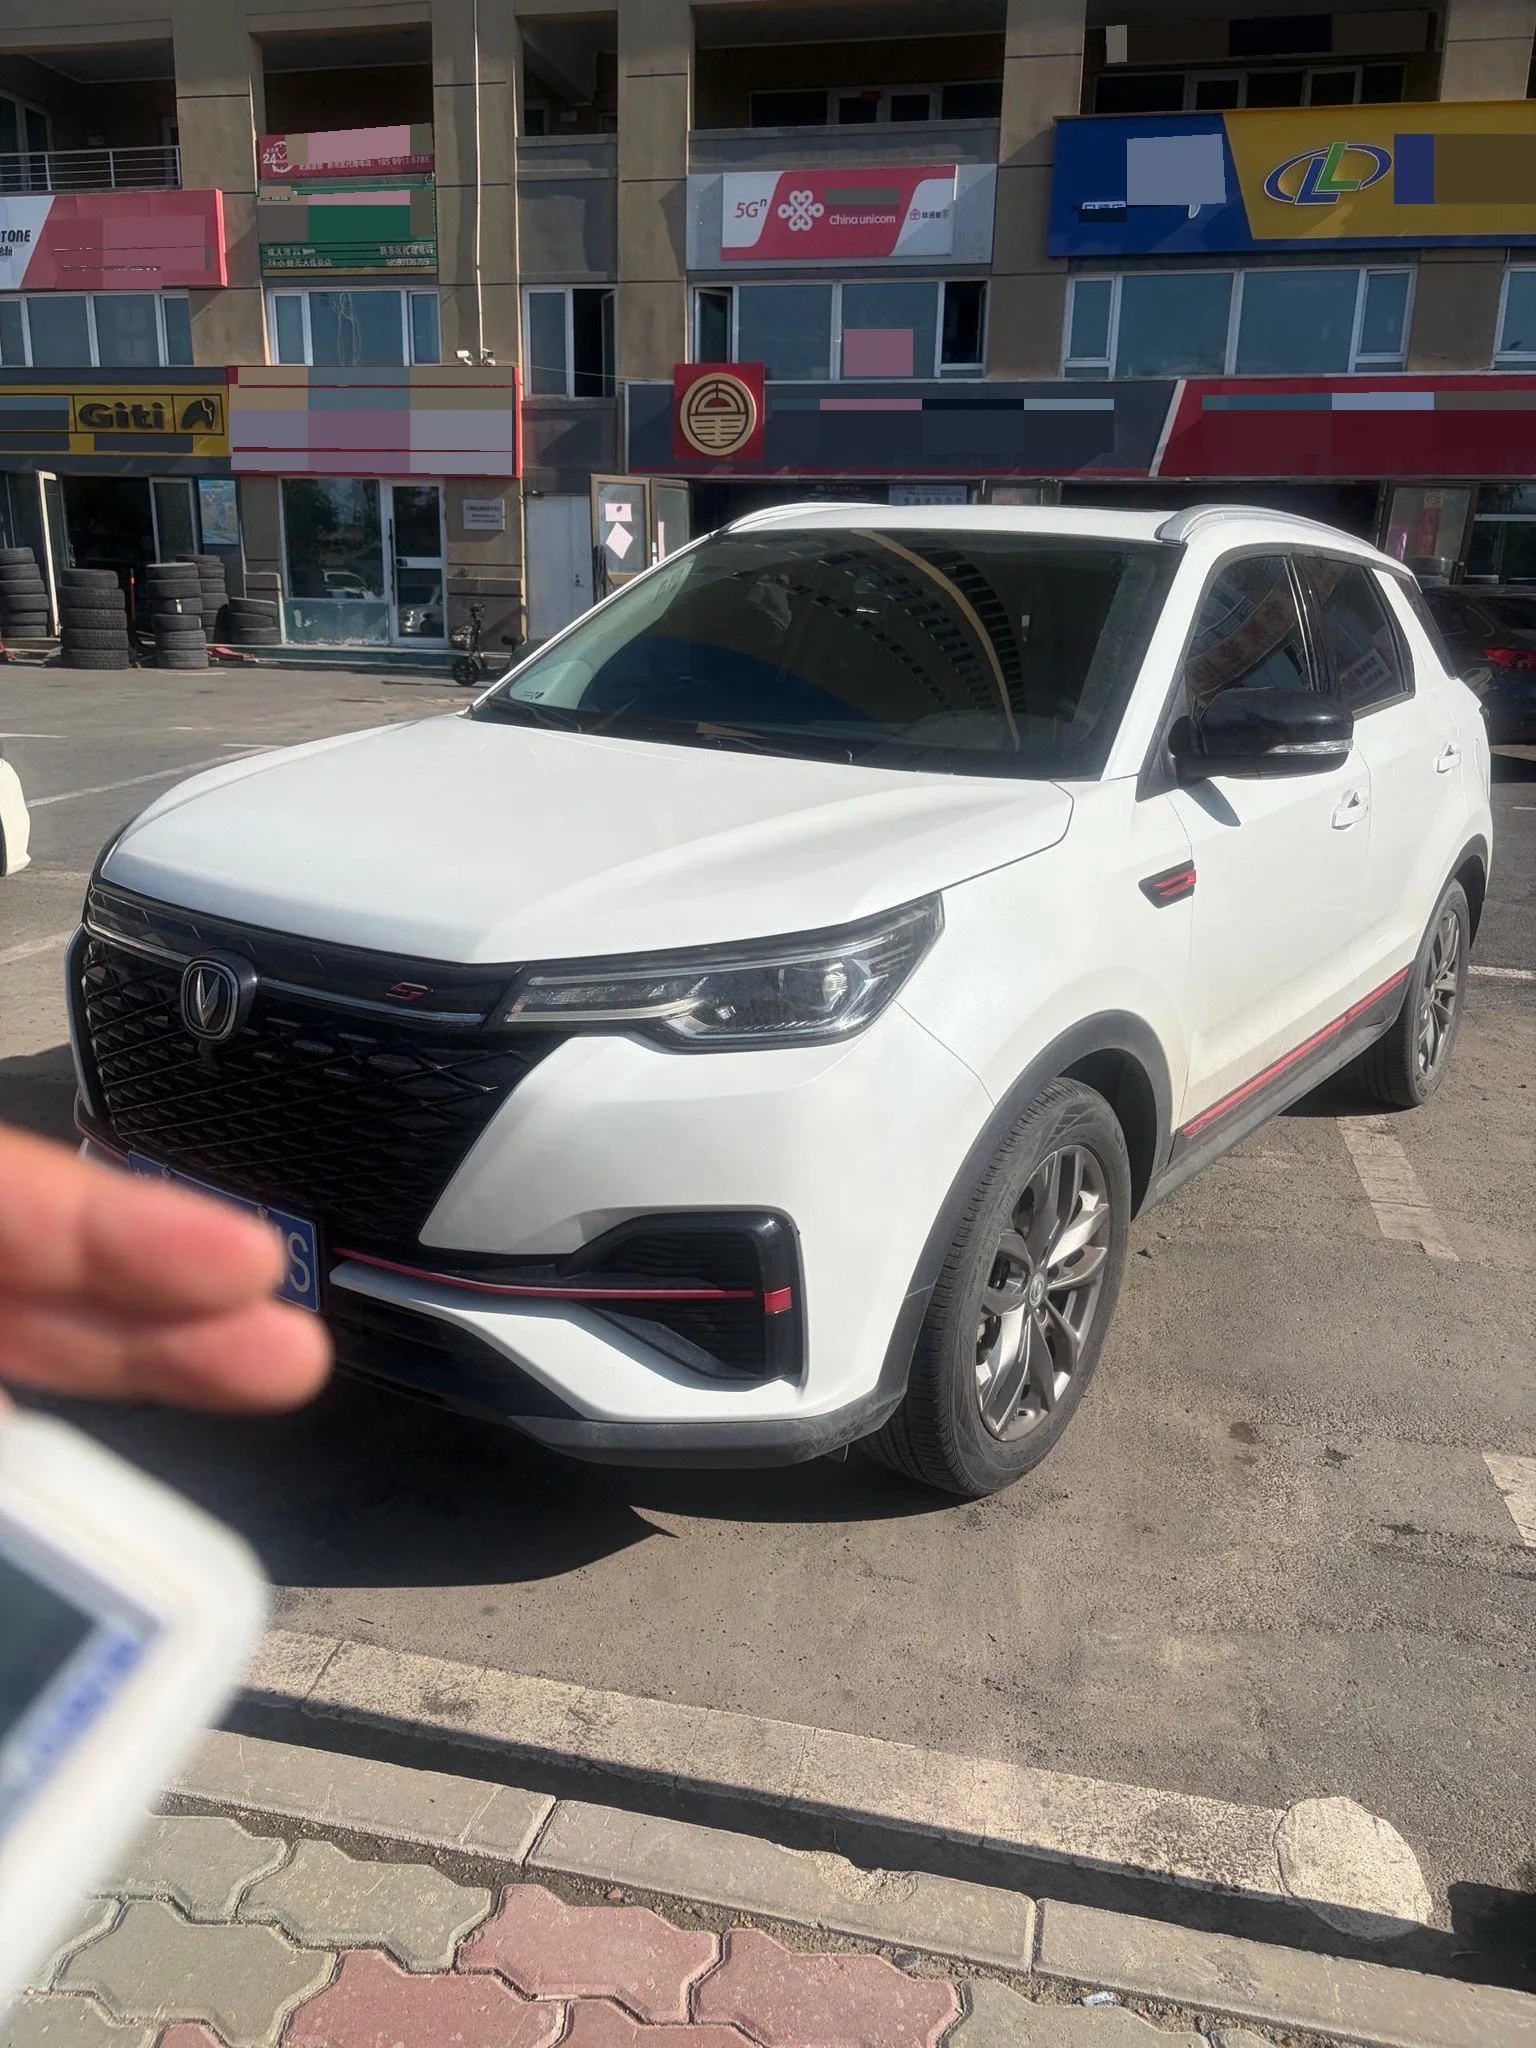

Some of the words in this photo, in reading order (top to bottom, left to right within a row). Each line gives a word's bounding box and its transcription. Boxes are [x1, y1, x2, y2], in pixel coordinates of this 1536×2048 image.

[829, 215, 857, 225] China
[859, 215, 896, 225] unicom
[79, 402, 164, 429] Giti
